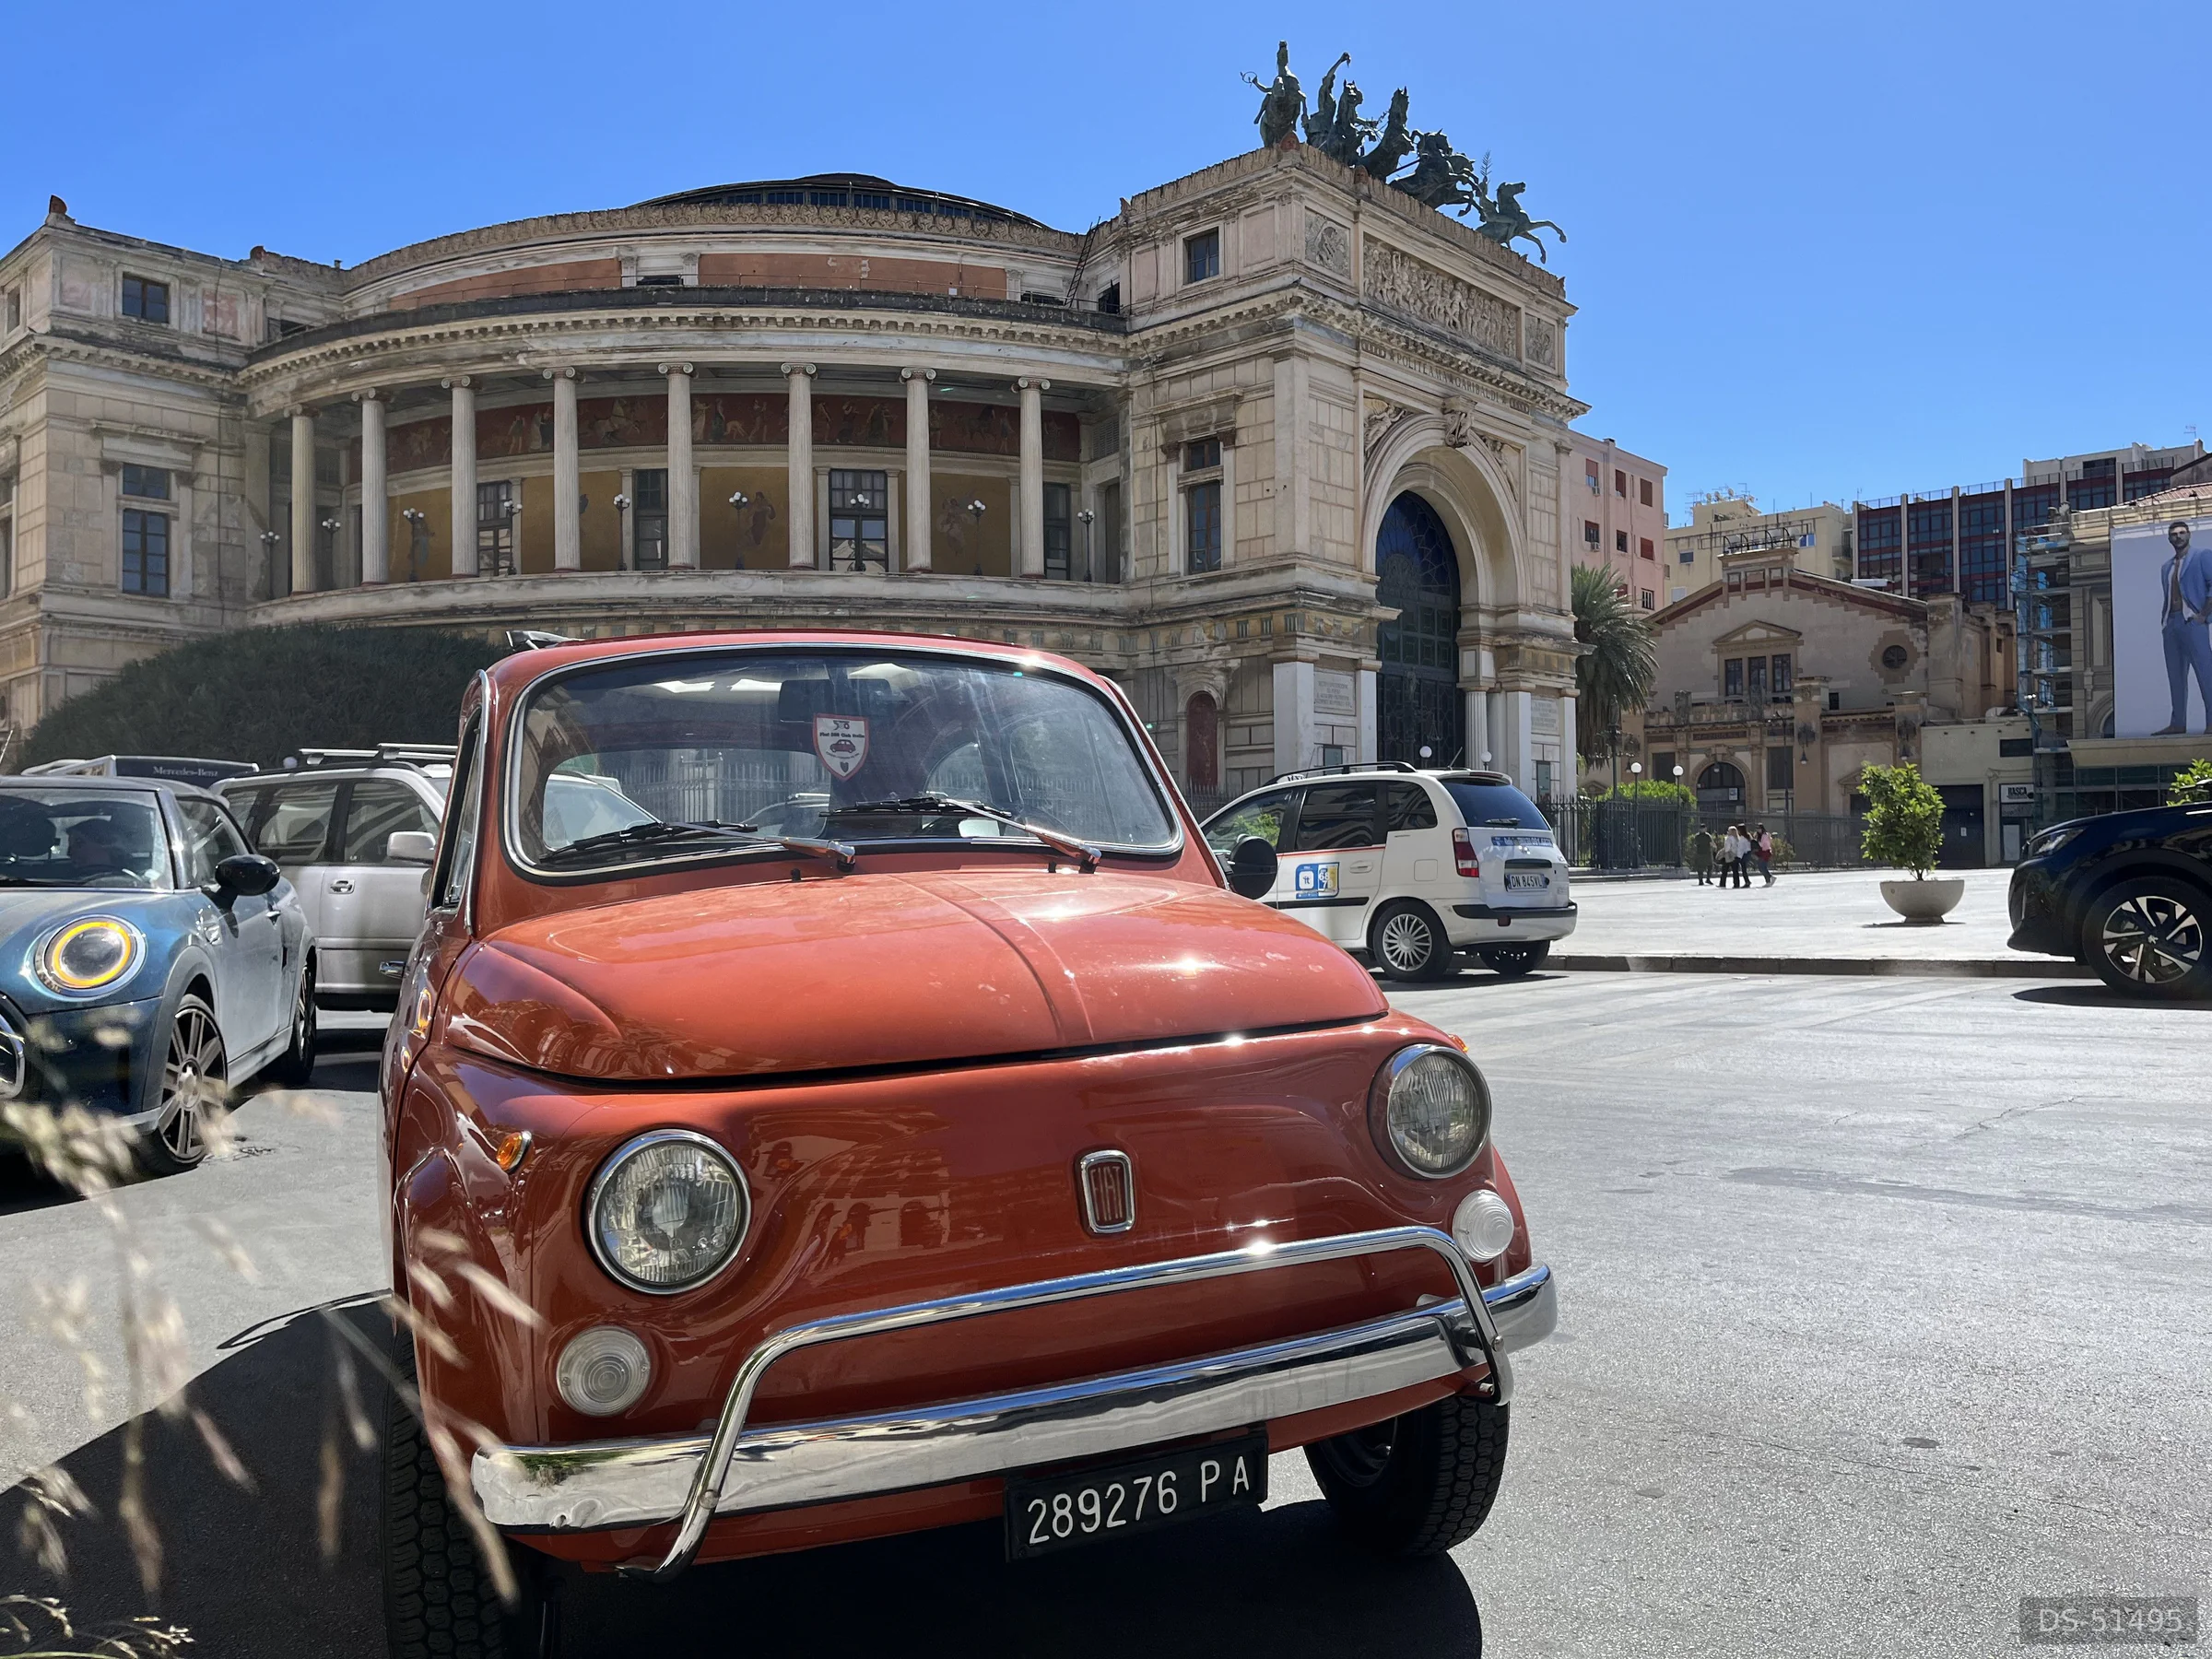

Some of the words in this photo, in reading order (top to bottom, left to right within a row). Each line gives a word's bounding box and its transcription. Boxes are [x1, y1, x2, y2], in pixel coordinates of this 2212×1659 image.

[1396, 354, 1449, 384] POLITEAMA
[1455, 377, 1500, 404] GARIBALDI
[152, 766, 218, 777] Mercedes-Benz
[1511, 876, 1521, 888] DN
[1089, 1166, 1123, 1221] FIAT
[1027, 1471, 1177, 1545] 289276
